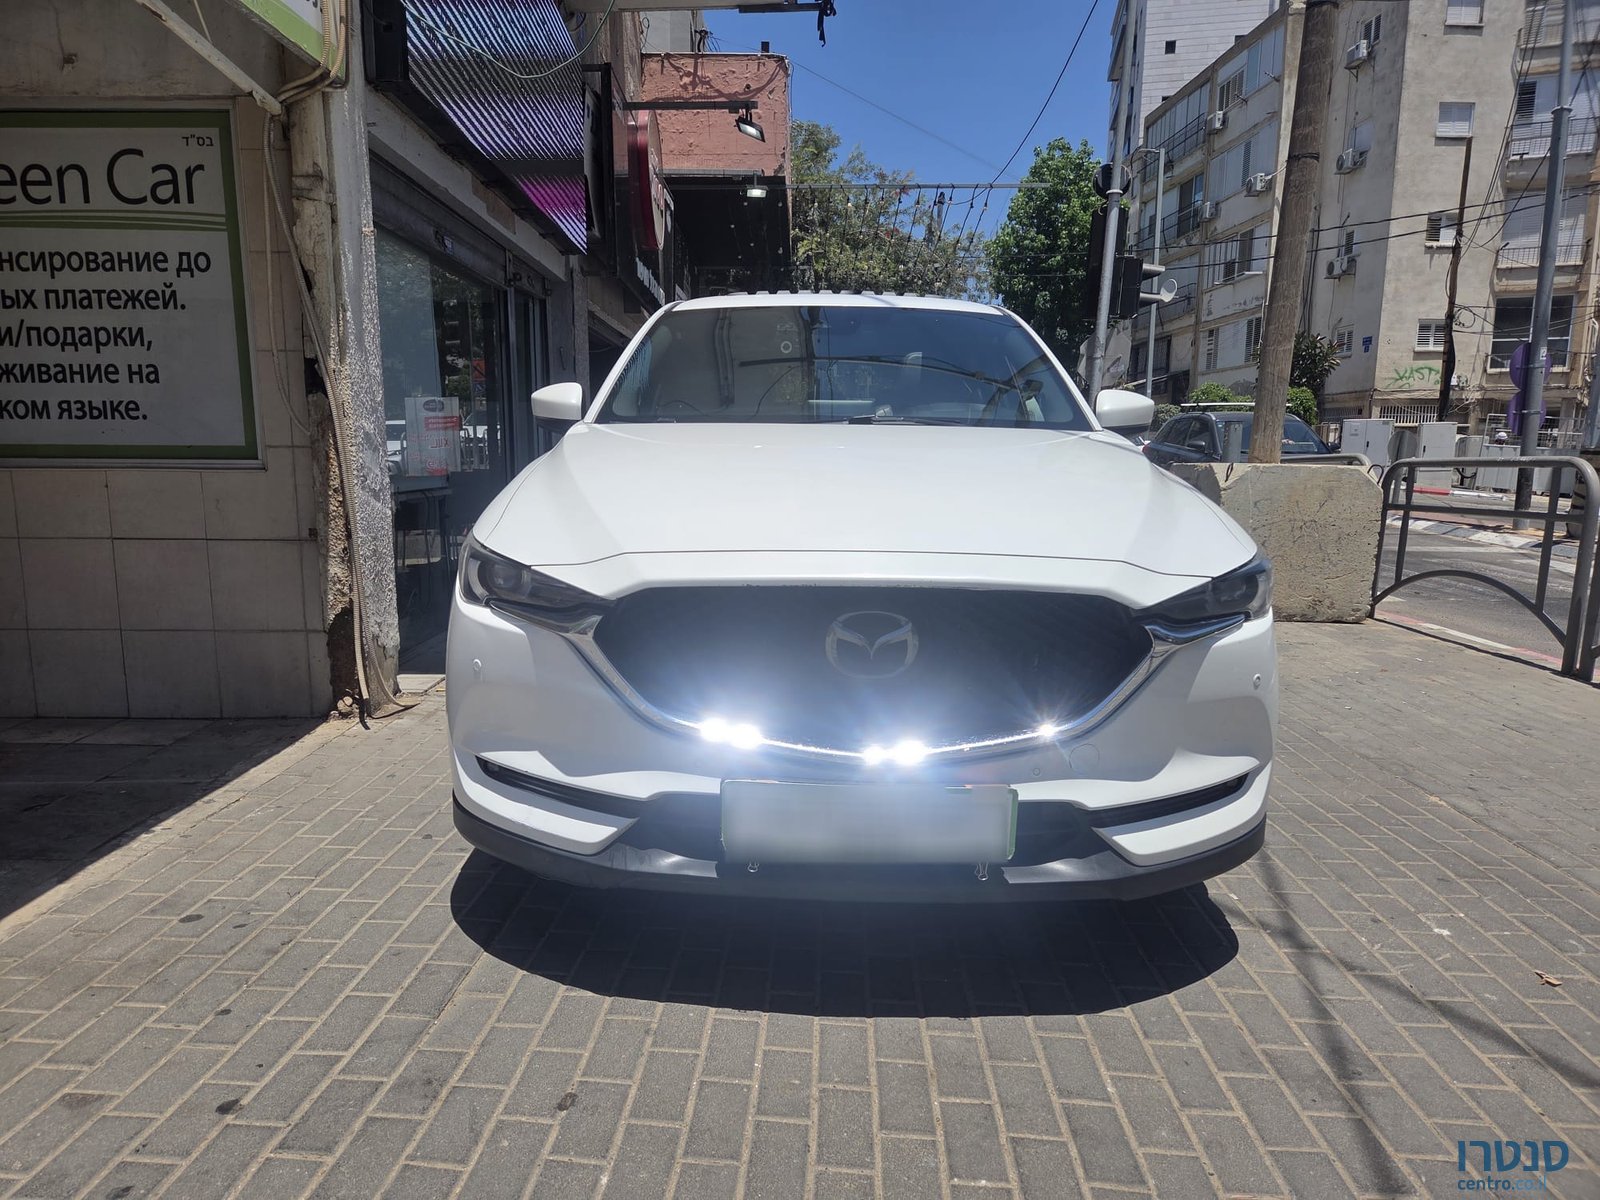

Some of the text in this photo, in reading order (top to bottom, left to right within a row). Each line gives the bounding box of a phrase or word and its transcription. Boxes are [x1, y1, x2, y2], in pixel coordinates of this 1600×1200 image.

[181, 133, 214, 147] בס"ד
[106, 148, 205, 205] Car
[176, 251, 212, 278] до
[0, 282, 186, 311] ых платежей.
[0, 319, 153, 353] и/подарки,
[0, 362, 161, 384] живание на
[0, 399, 148, 421] ком языке.
